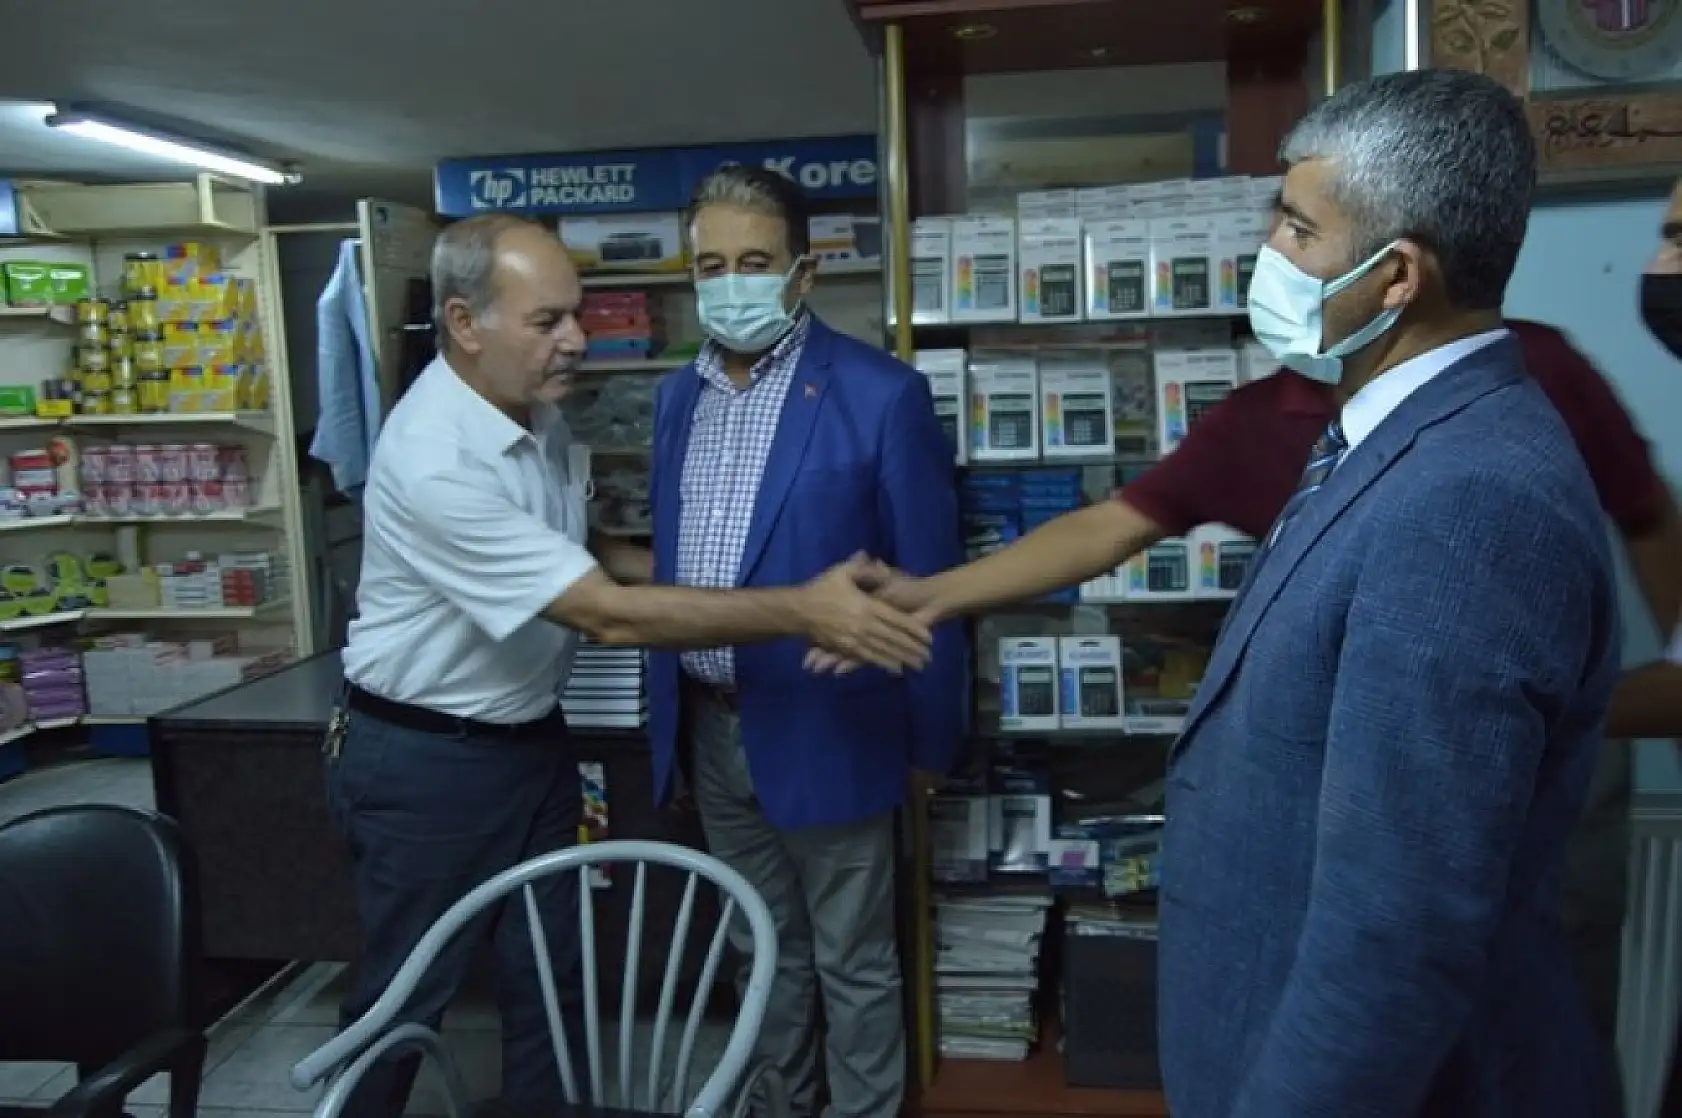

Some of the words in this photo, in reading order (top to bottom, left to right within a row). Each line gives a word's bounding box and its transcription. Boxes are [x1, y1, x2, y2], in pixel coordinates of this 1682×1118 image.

[532, 164, 636, 184] HEWLETT
[482, 170, 514, 207] hp
[531, 184, 634, 205] PACKARD
